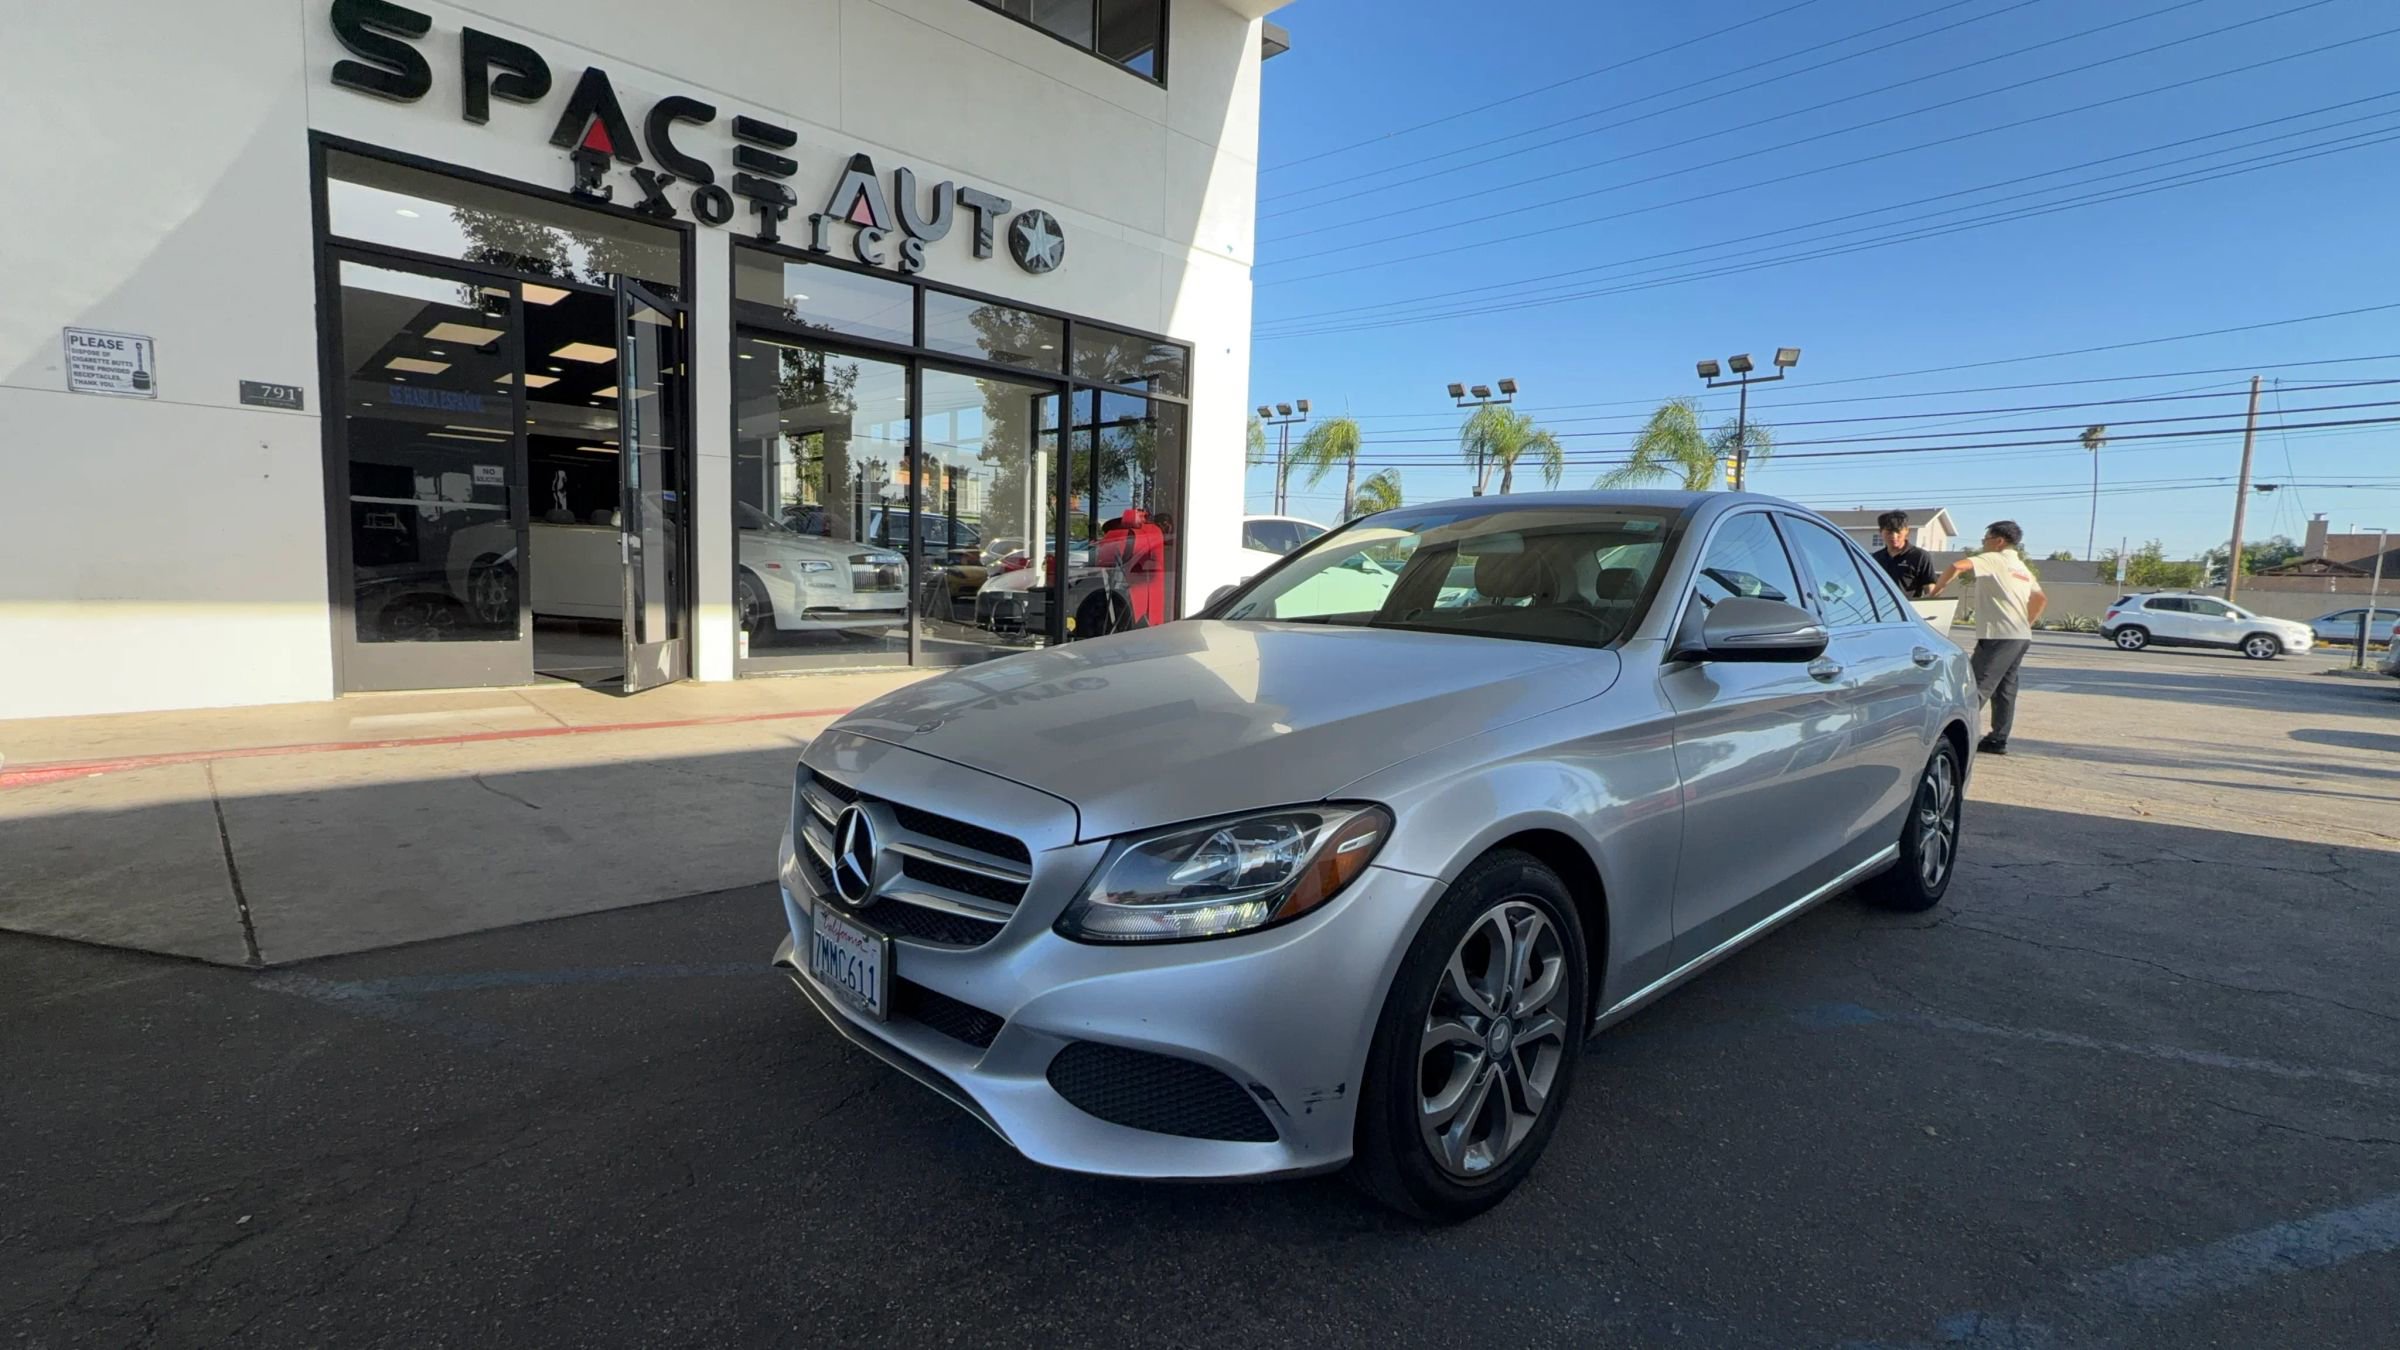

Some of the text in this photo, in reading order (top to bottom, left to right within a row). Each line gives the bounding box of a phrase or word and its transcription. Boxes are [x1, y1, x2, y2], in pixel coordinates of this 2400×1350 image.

[330, 0, 798, 207] SPACE
[570, 149, 926, 274] EXOTICS
[70, 335, 124, 351] PLEASE
[71, 348, 100, 357] DISPOSE
[72, 355, 110, 365] CIGARETTE
[97, 366, 130, 375] PROVIDED
[260, 385, 295, 400] 791
[824, 914, 868, 953] California
[815, 931, 877, 1007] 7MMC611
